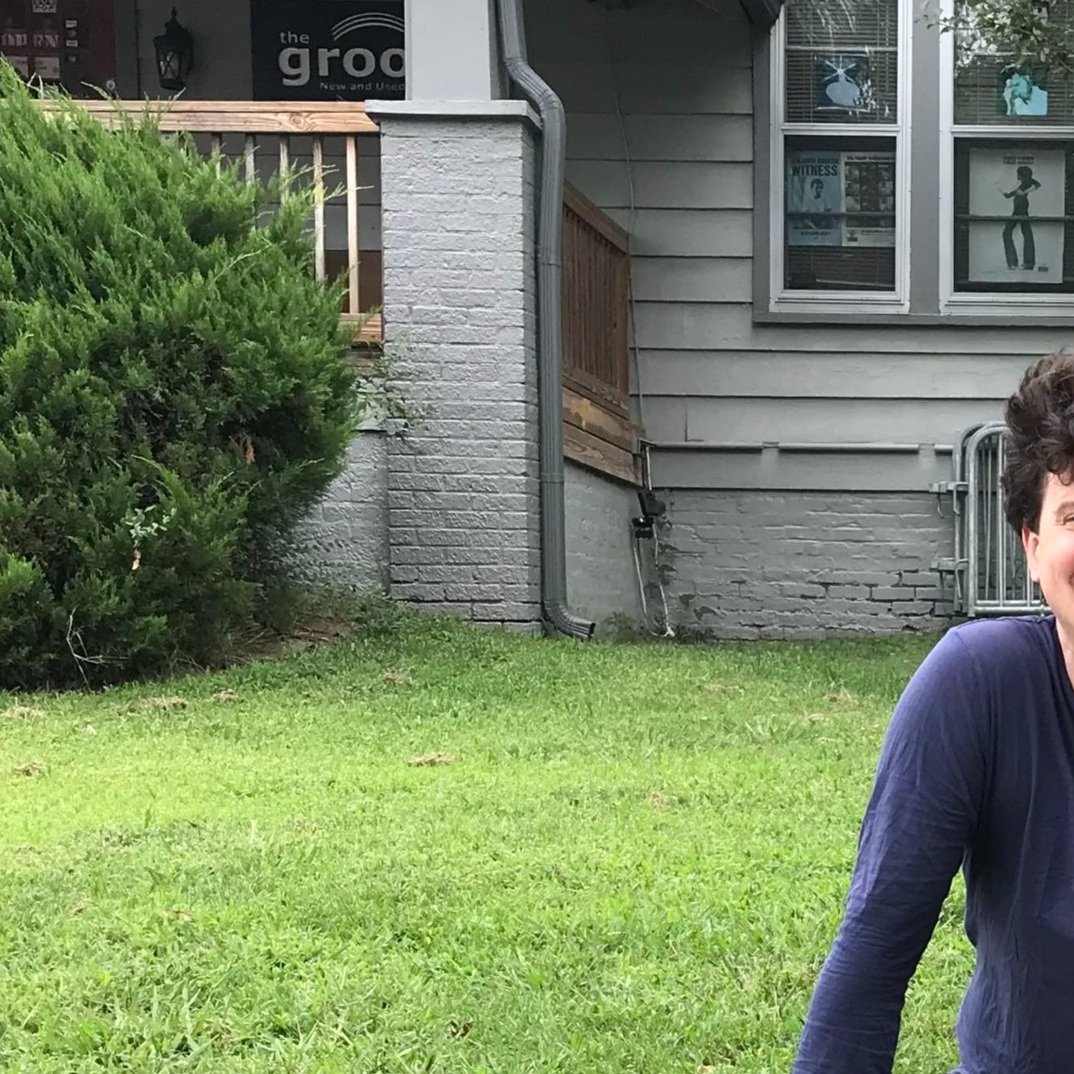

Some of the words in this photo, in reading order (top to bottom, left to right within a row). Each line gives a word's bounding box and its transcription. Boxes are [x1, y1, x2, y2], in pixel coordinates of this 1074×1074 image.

[280, 31, 310, 44] the
[320, 82, 346, 91] New
[350, 81, 372, 91] and
[792, 165, 838, 177] WITNESS
